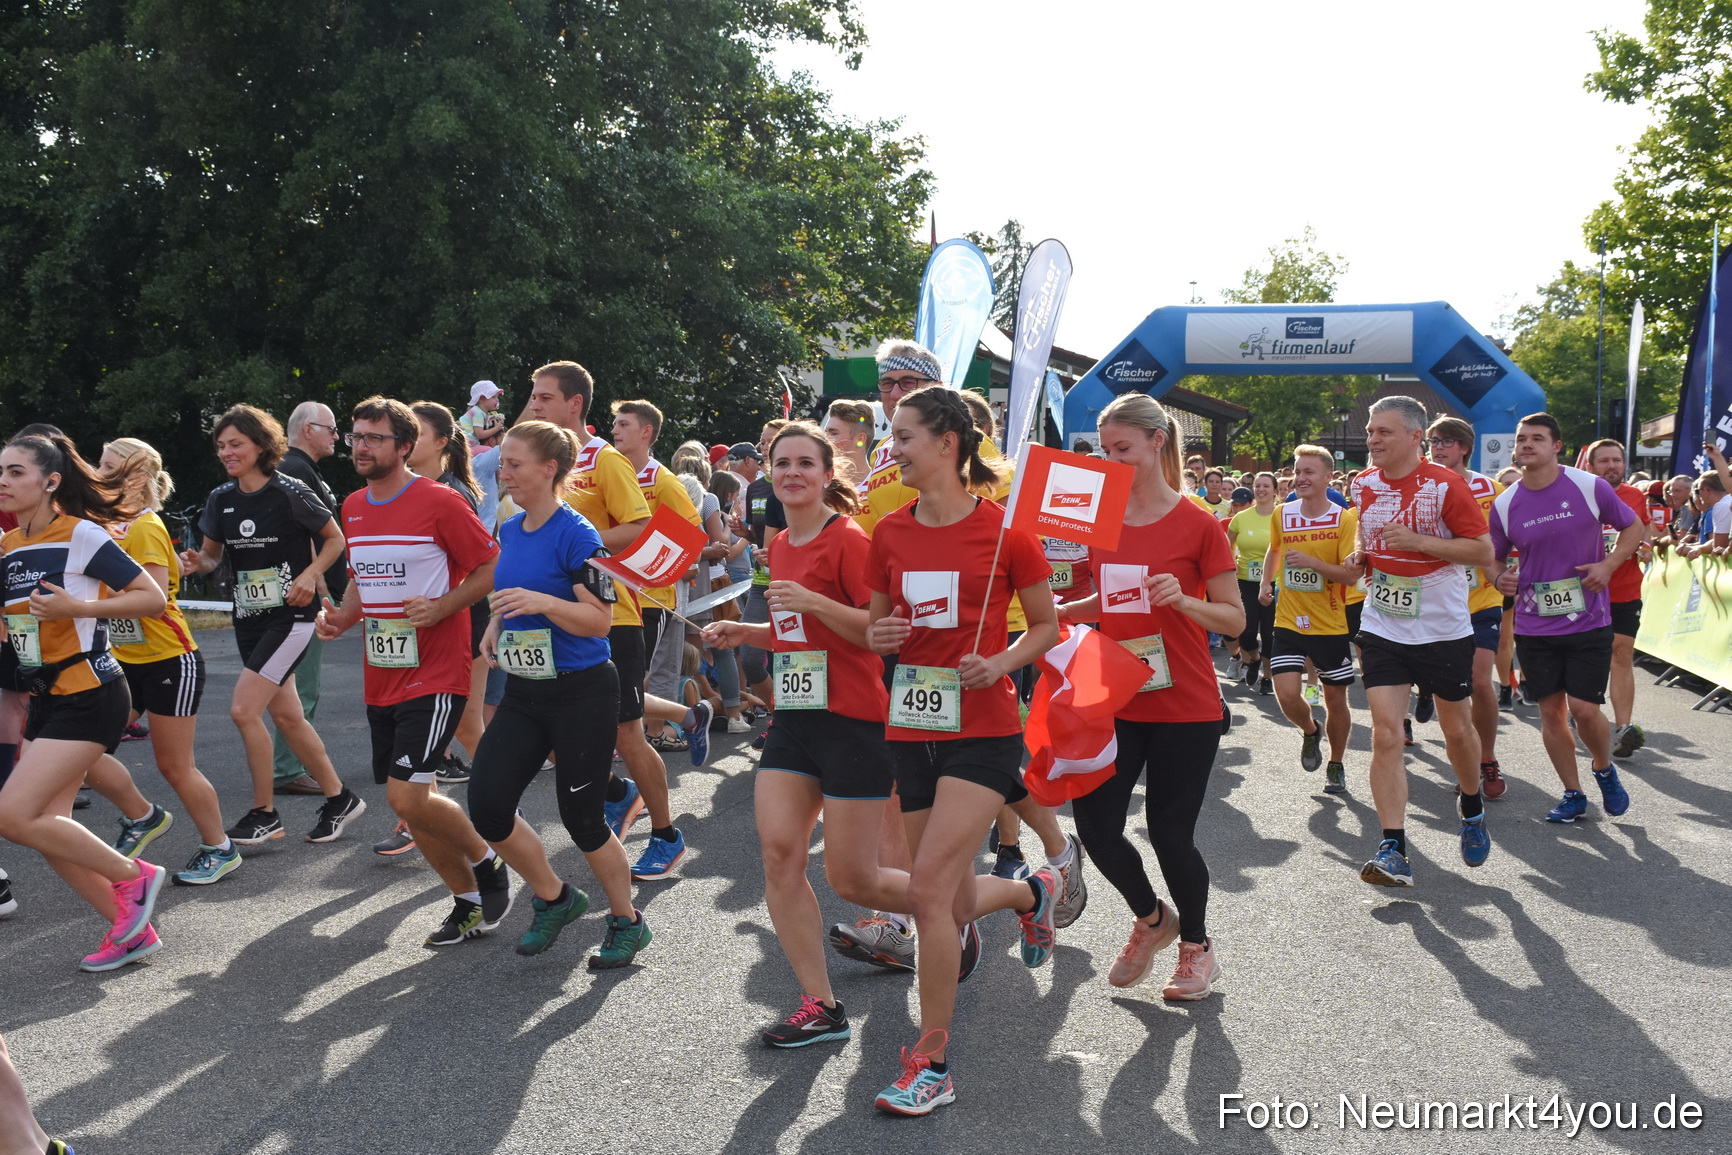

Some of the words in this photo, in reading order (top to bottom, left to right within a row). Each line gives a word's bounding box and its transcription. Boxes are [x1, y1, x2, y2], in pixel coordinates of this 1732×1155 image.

[1293, 324, 1322, 333] Fischer
[1271, 338, 1357, 355] firmenlauf
[1113, 367, 1158, 378] Fischer
[867, 469, 899, 493] MAX
[1060, 496, 1082, 505] DEHN
[1038, 514, 1061, 527] DEHN
[1060, 519, 1094, 535] protects.
[1522, 518, 1537, 529] WIR
[1536, 514, 1555, 524] SIND
[1555, 510, 1575, 520] LILA.
[1282, 534, 1307, 545] MAX
[1310, 530, 1340, 542] BÖGL
[7, 569, 47, 586] Fischer
[355, 561, 407, 579] Petry
[1287, 569, 1319, 585] 1690
[244, 583, 268, 599] 101
[372, 580, 388, 588] KÄLTE
[389, 579, 408, 588] KLIMA
[1116, 592, 1133, 602] DEHN
[1374, 584, 1413, 607] 2215
[1543, 590, 1573, 608] 904
[918, 603, 937, 615] DEHN
[109, 618, 136, 635] 589
[369, 634, 408, 655] 1817
[503, 648, 546, 667] 1138
[781, 672, 813, 694] 505
[902, 687, 943, 714] 499
[921, 710, 949, 721] Christine
